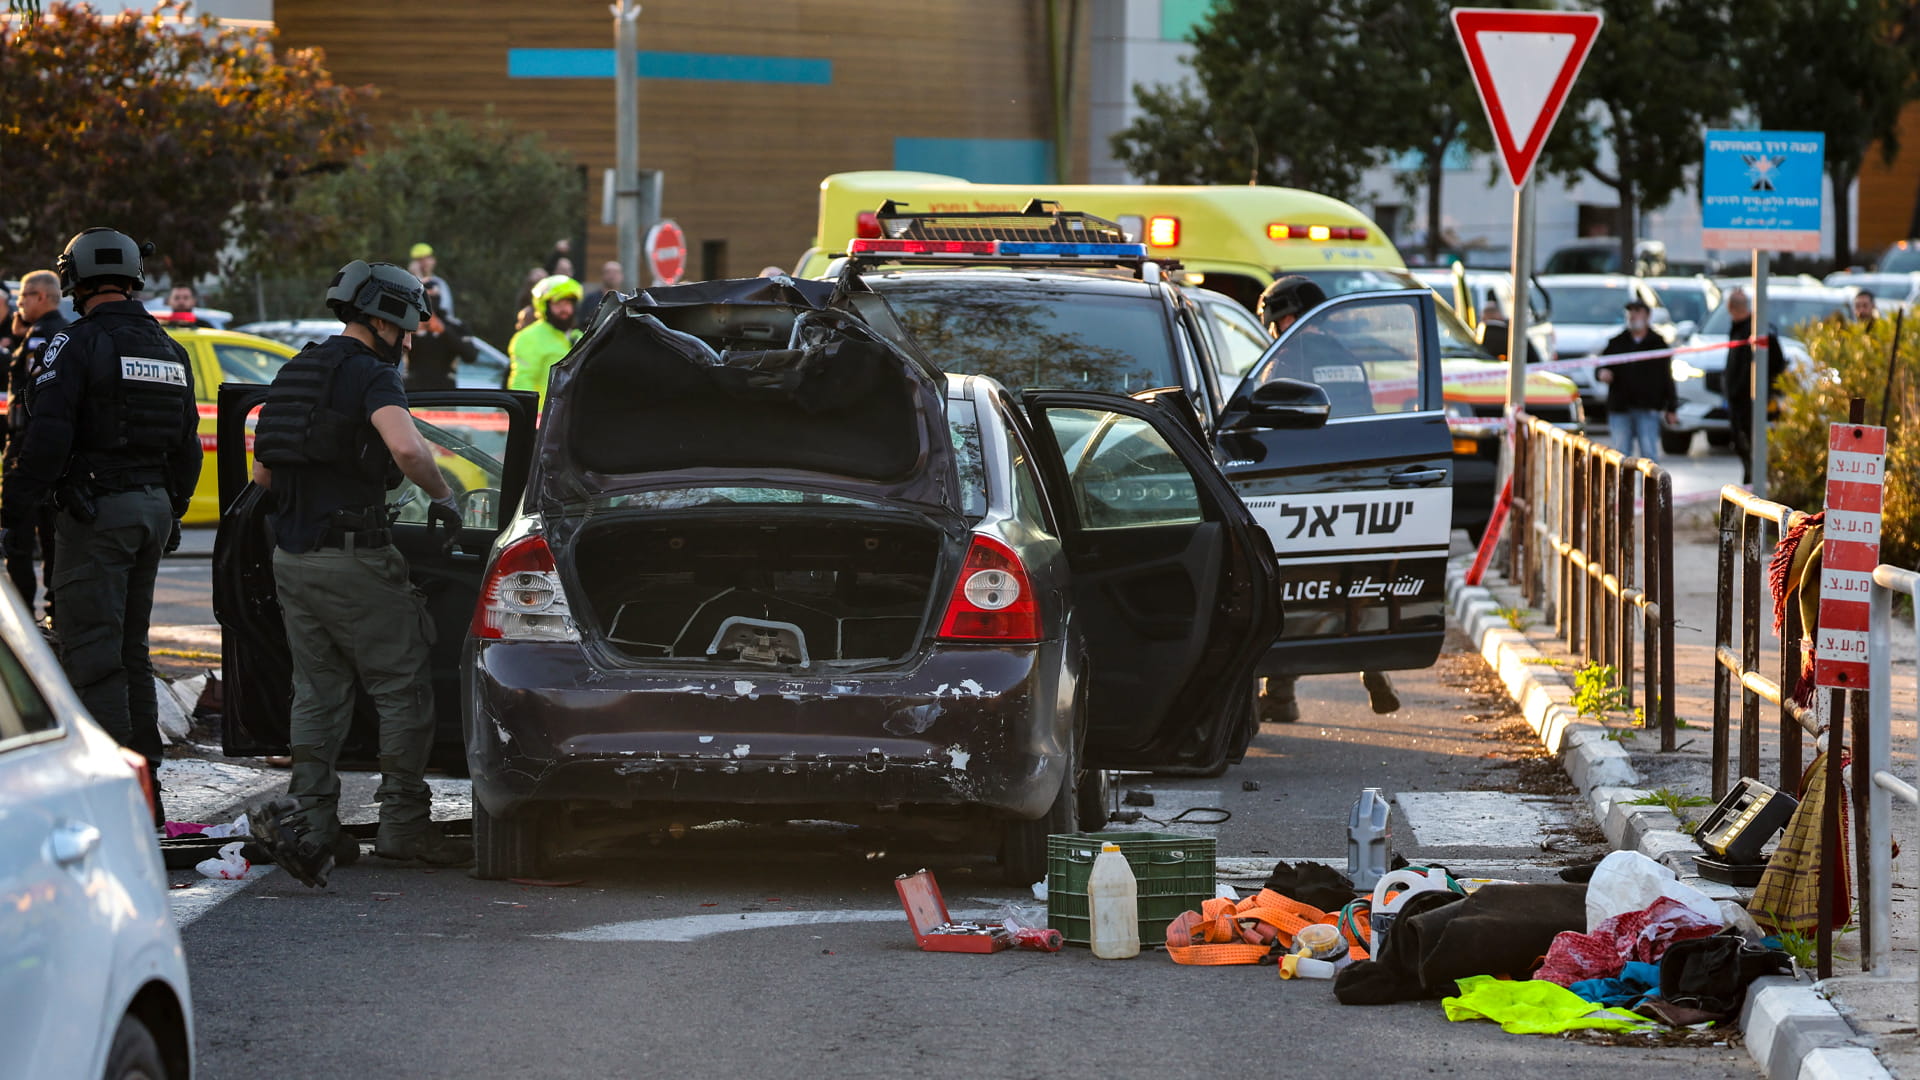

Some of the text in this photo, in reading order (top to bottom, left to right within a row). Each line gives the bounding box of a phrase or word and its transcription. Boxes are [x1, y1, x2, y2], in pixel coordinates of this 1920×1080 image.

[126, 361, 159, 378] חבלה
[1280, 501, 1414, 539] ישראל
[1281, 580, 1331, 601] LICE
[1824, 577, 1869, 593] מ.ע.צ.
[1820, 637, 1865, 653] מ.ע.צ.
